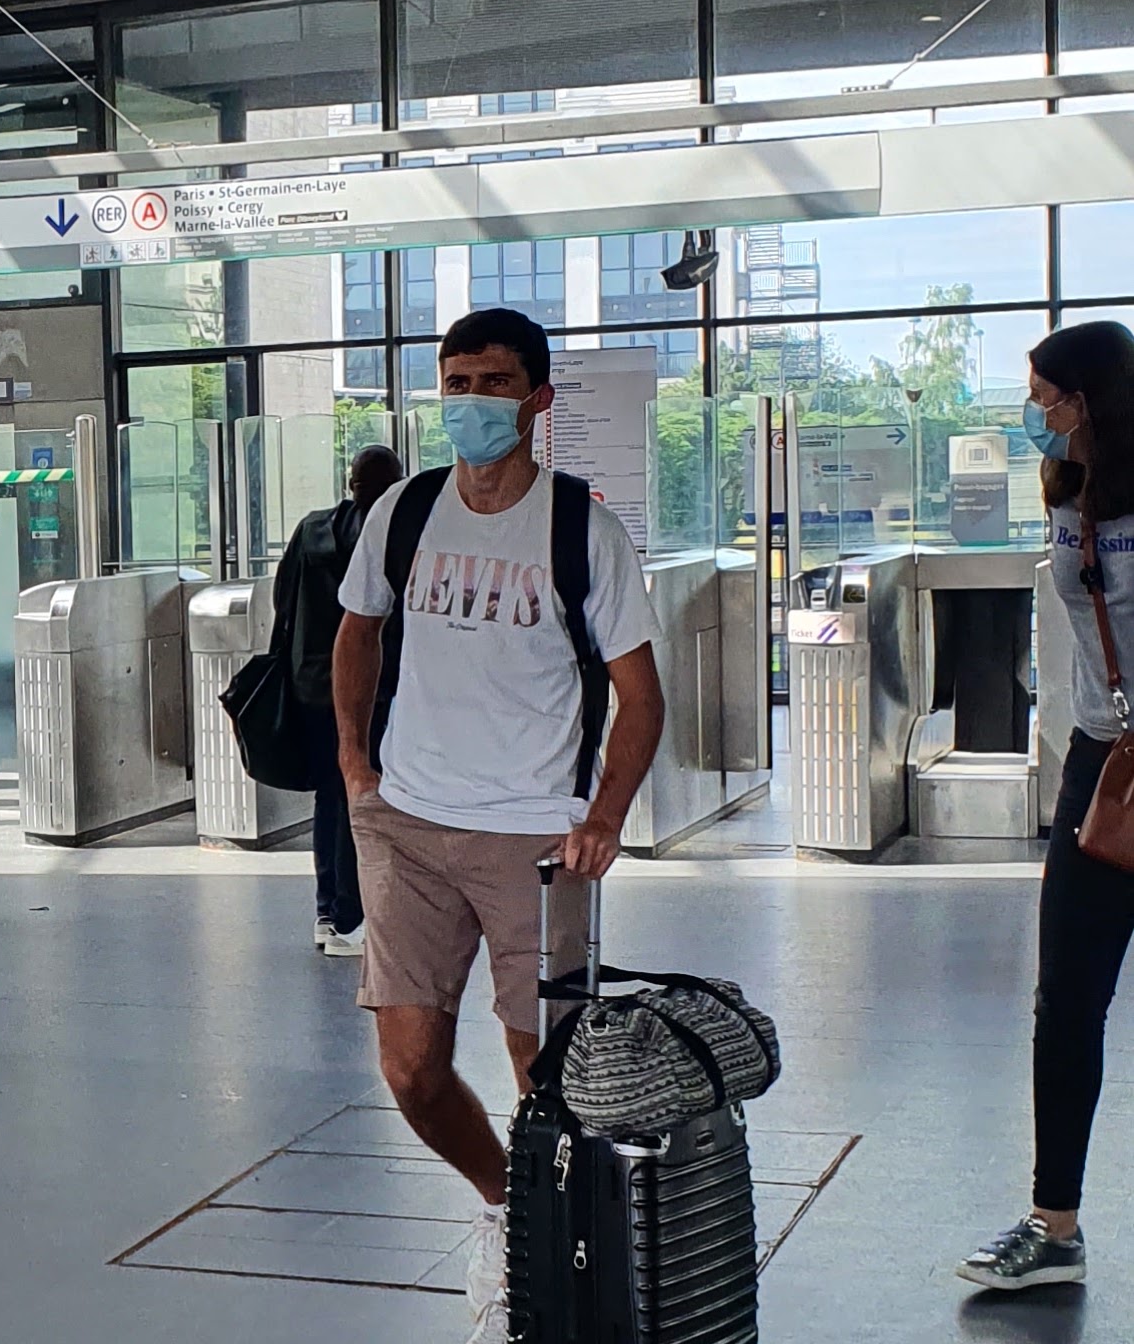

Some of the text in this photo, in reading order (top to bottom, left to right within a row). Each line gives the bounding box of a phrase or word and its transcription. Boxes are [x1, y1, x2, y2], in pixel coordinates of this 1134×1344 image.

[174, 180, 347, 202] Paris St-Germain-en-Laye
[97, 202, 158, 222] RER A
[174, 200, 264, 220] Poissy Cergy
[174, 215, 275, 233] Marne-la-Vallée
[1057, 525, 1134, 553] Beissi
[407, 550, 547, 628] LEVI'S
